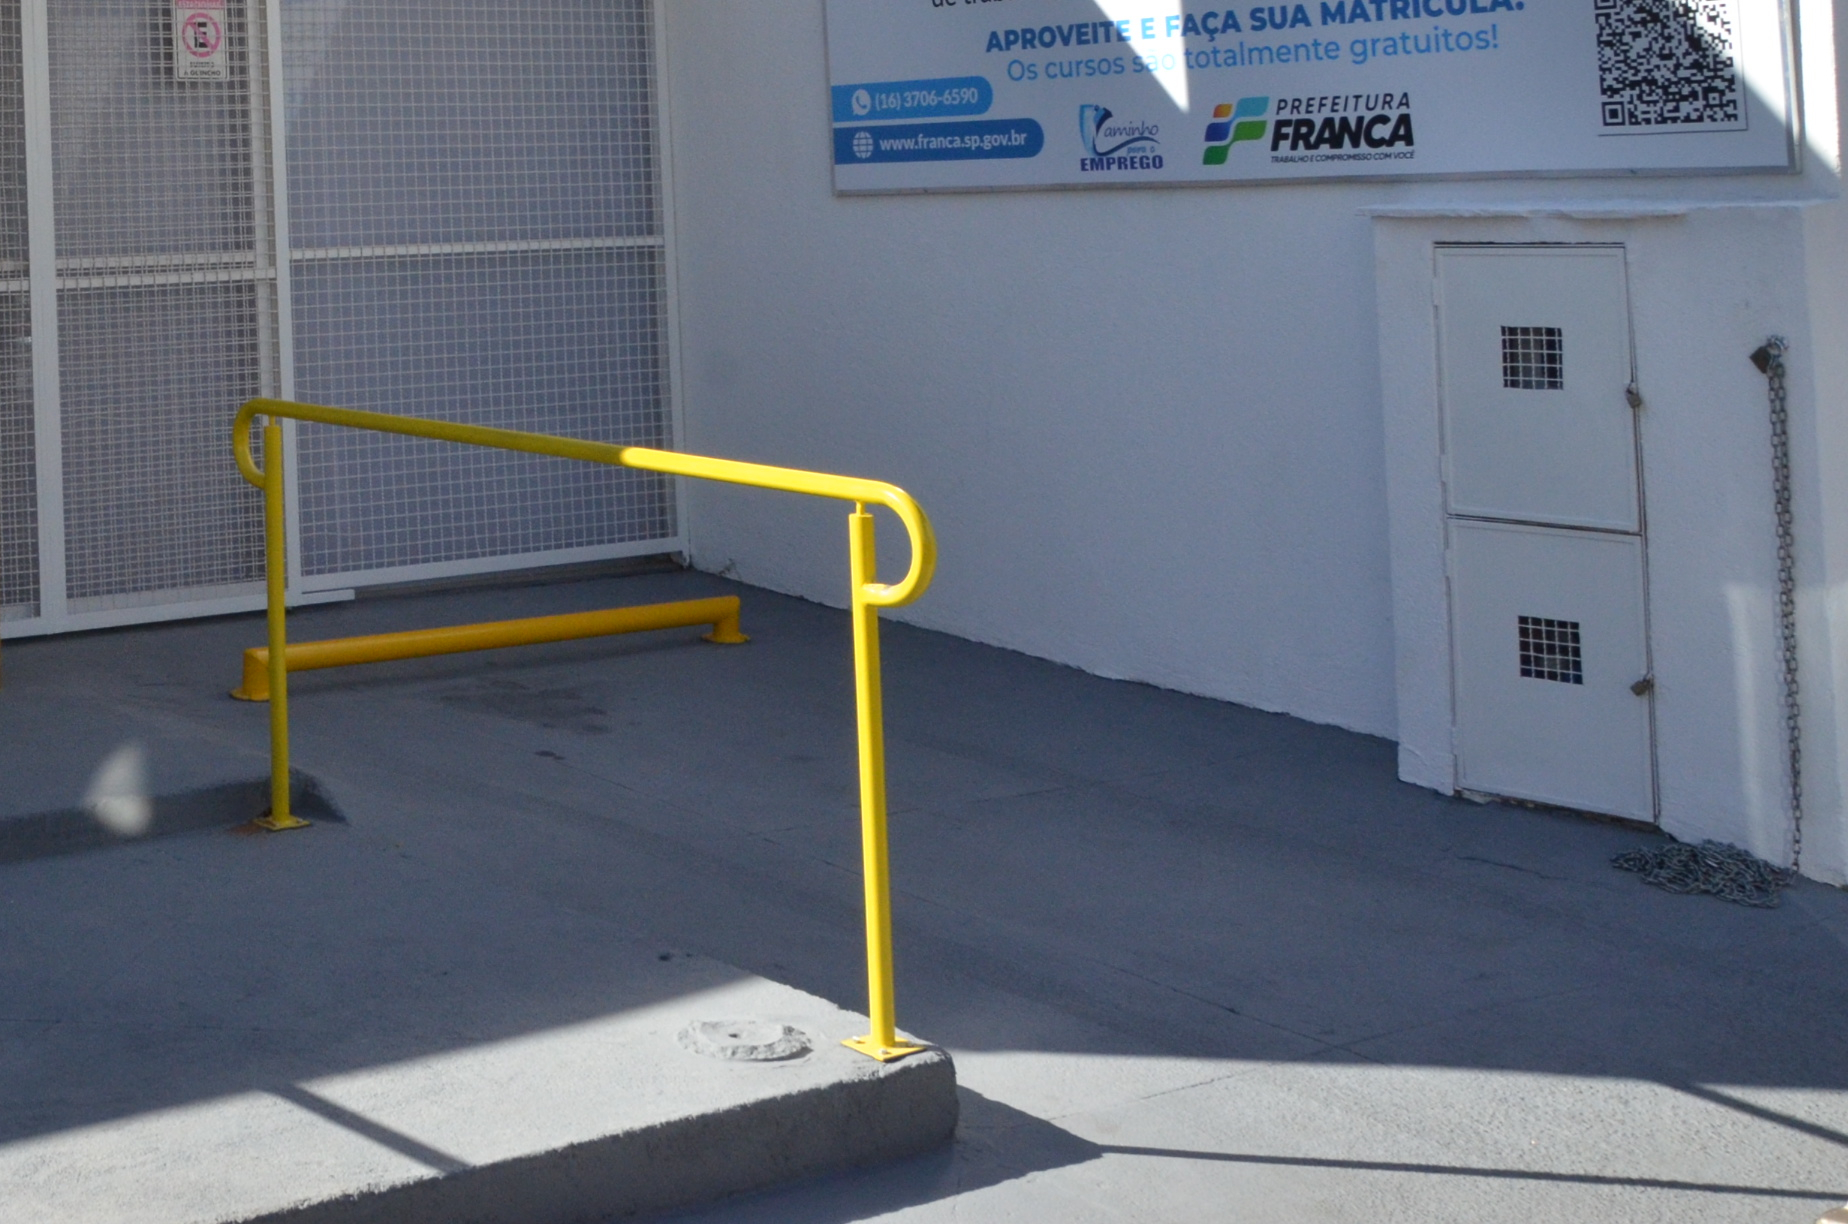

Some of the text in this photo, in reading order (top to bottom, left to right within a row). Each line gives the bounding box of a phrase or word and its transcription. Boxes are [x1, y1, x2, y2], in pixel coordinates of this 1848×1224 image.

[985, 20, 1131, 53] APROVEITE
[1141, 17, 1155, 40] E
[1165, 8, 1241, 42] FAÇA
[1249, 4, 1312, 32] SUA
[1007, 24, 1499, 81] Os cursos são totalmente gratuitos!
[875, 87, 979, 112] (16) 3706-6590
[1276, 92, 1410, 115] PREFEITURA
[879, 129, 1027, 151] www.franca.sp.gov.br
[1270, 113, 1414, 151] FRANCA
[1080, 155, 1164, 172] EMPREGO
[1271, 154, 1309, 163] TRABALHO
[1315, 152, 1372, 163] COMPROMISSO
[1374, 151, 1393, 161] COM
